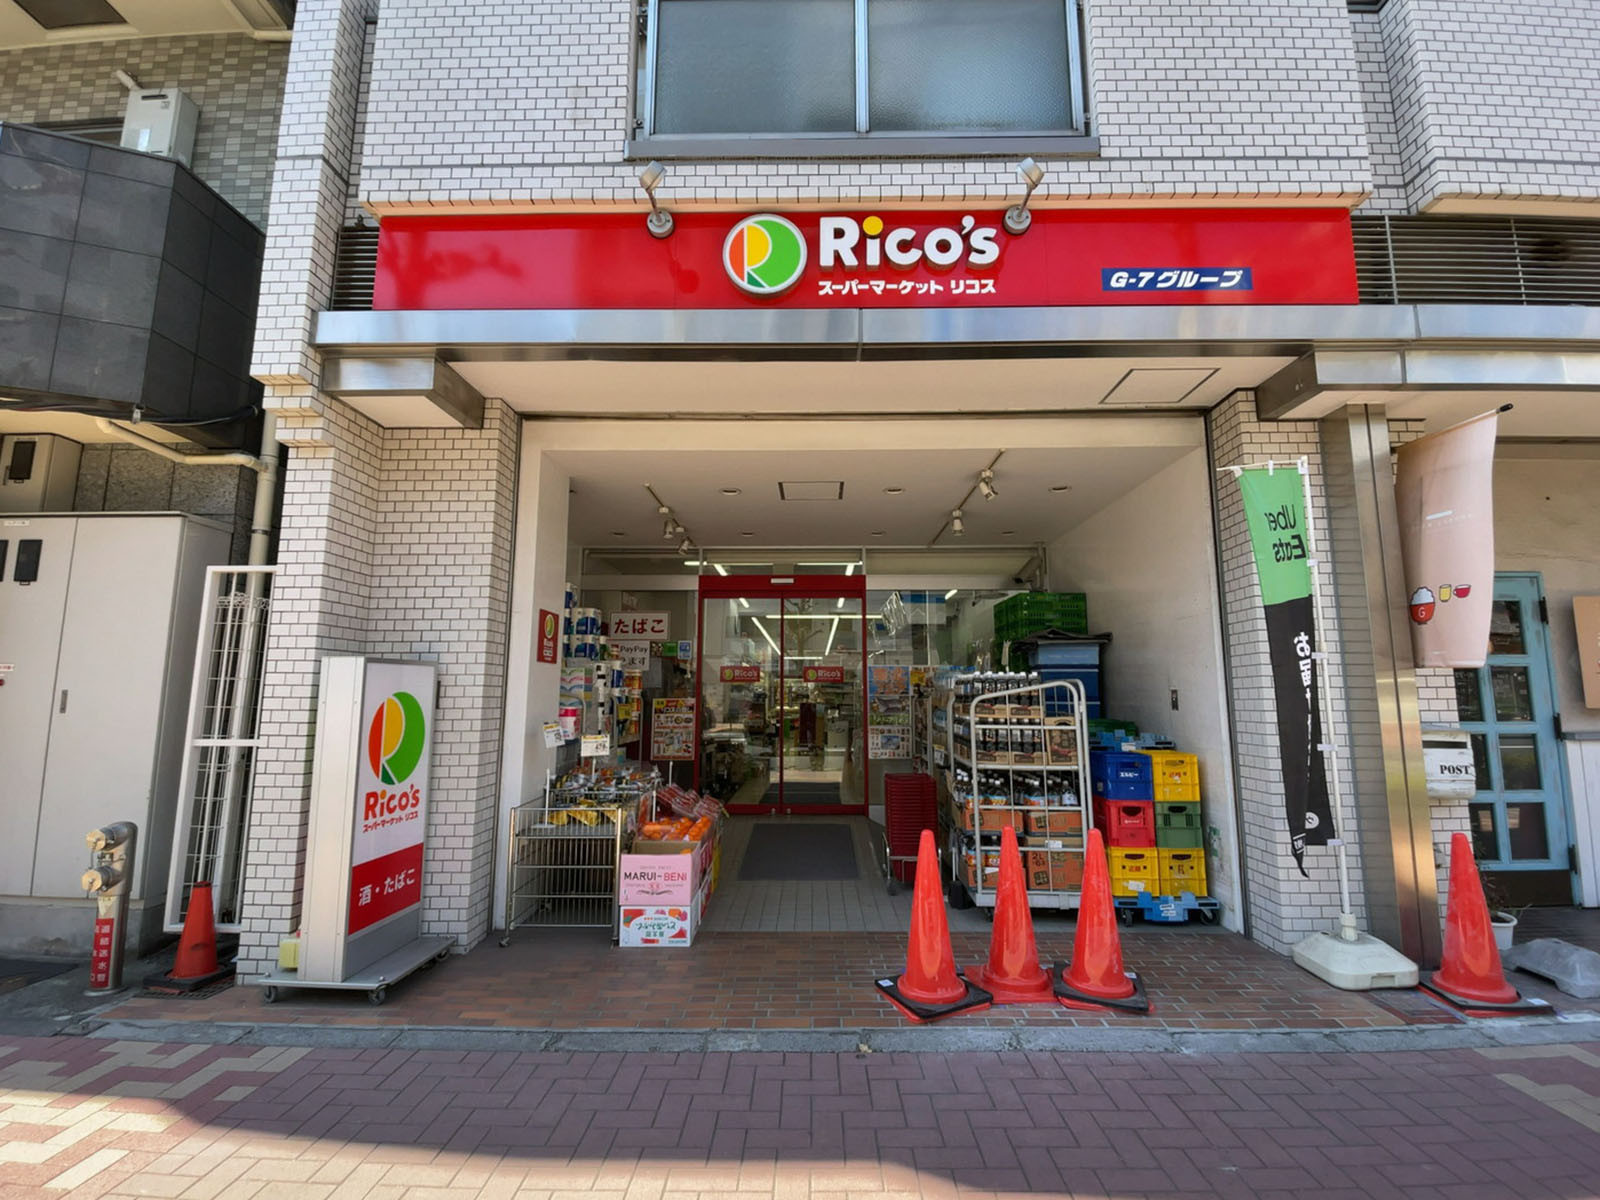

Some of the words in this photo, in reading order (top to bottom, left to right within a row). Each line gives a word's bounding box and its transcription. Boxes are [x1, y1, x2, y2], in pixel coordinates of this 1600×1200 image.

[819, 215, 1000, 267] Rico's
[818, 279, 944, 295] スーパーマーケット
[950, 279, 997, 295] リコス
[614, 618, 665, 634] たばこ
[620, 645, 648, 654] PayPay
[1440, 764, 1471, 775] POST
[364, 784, 420, 821] Rico's
[358, 868, 416, 907] 酒・たばこ
